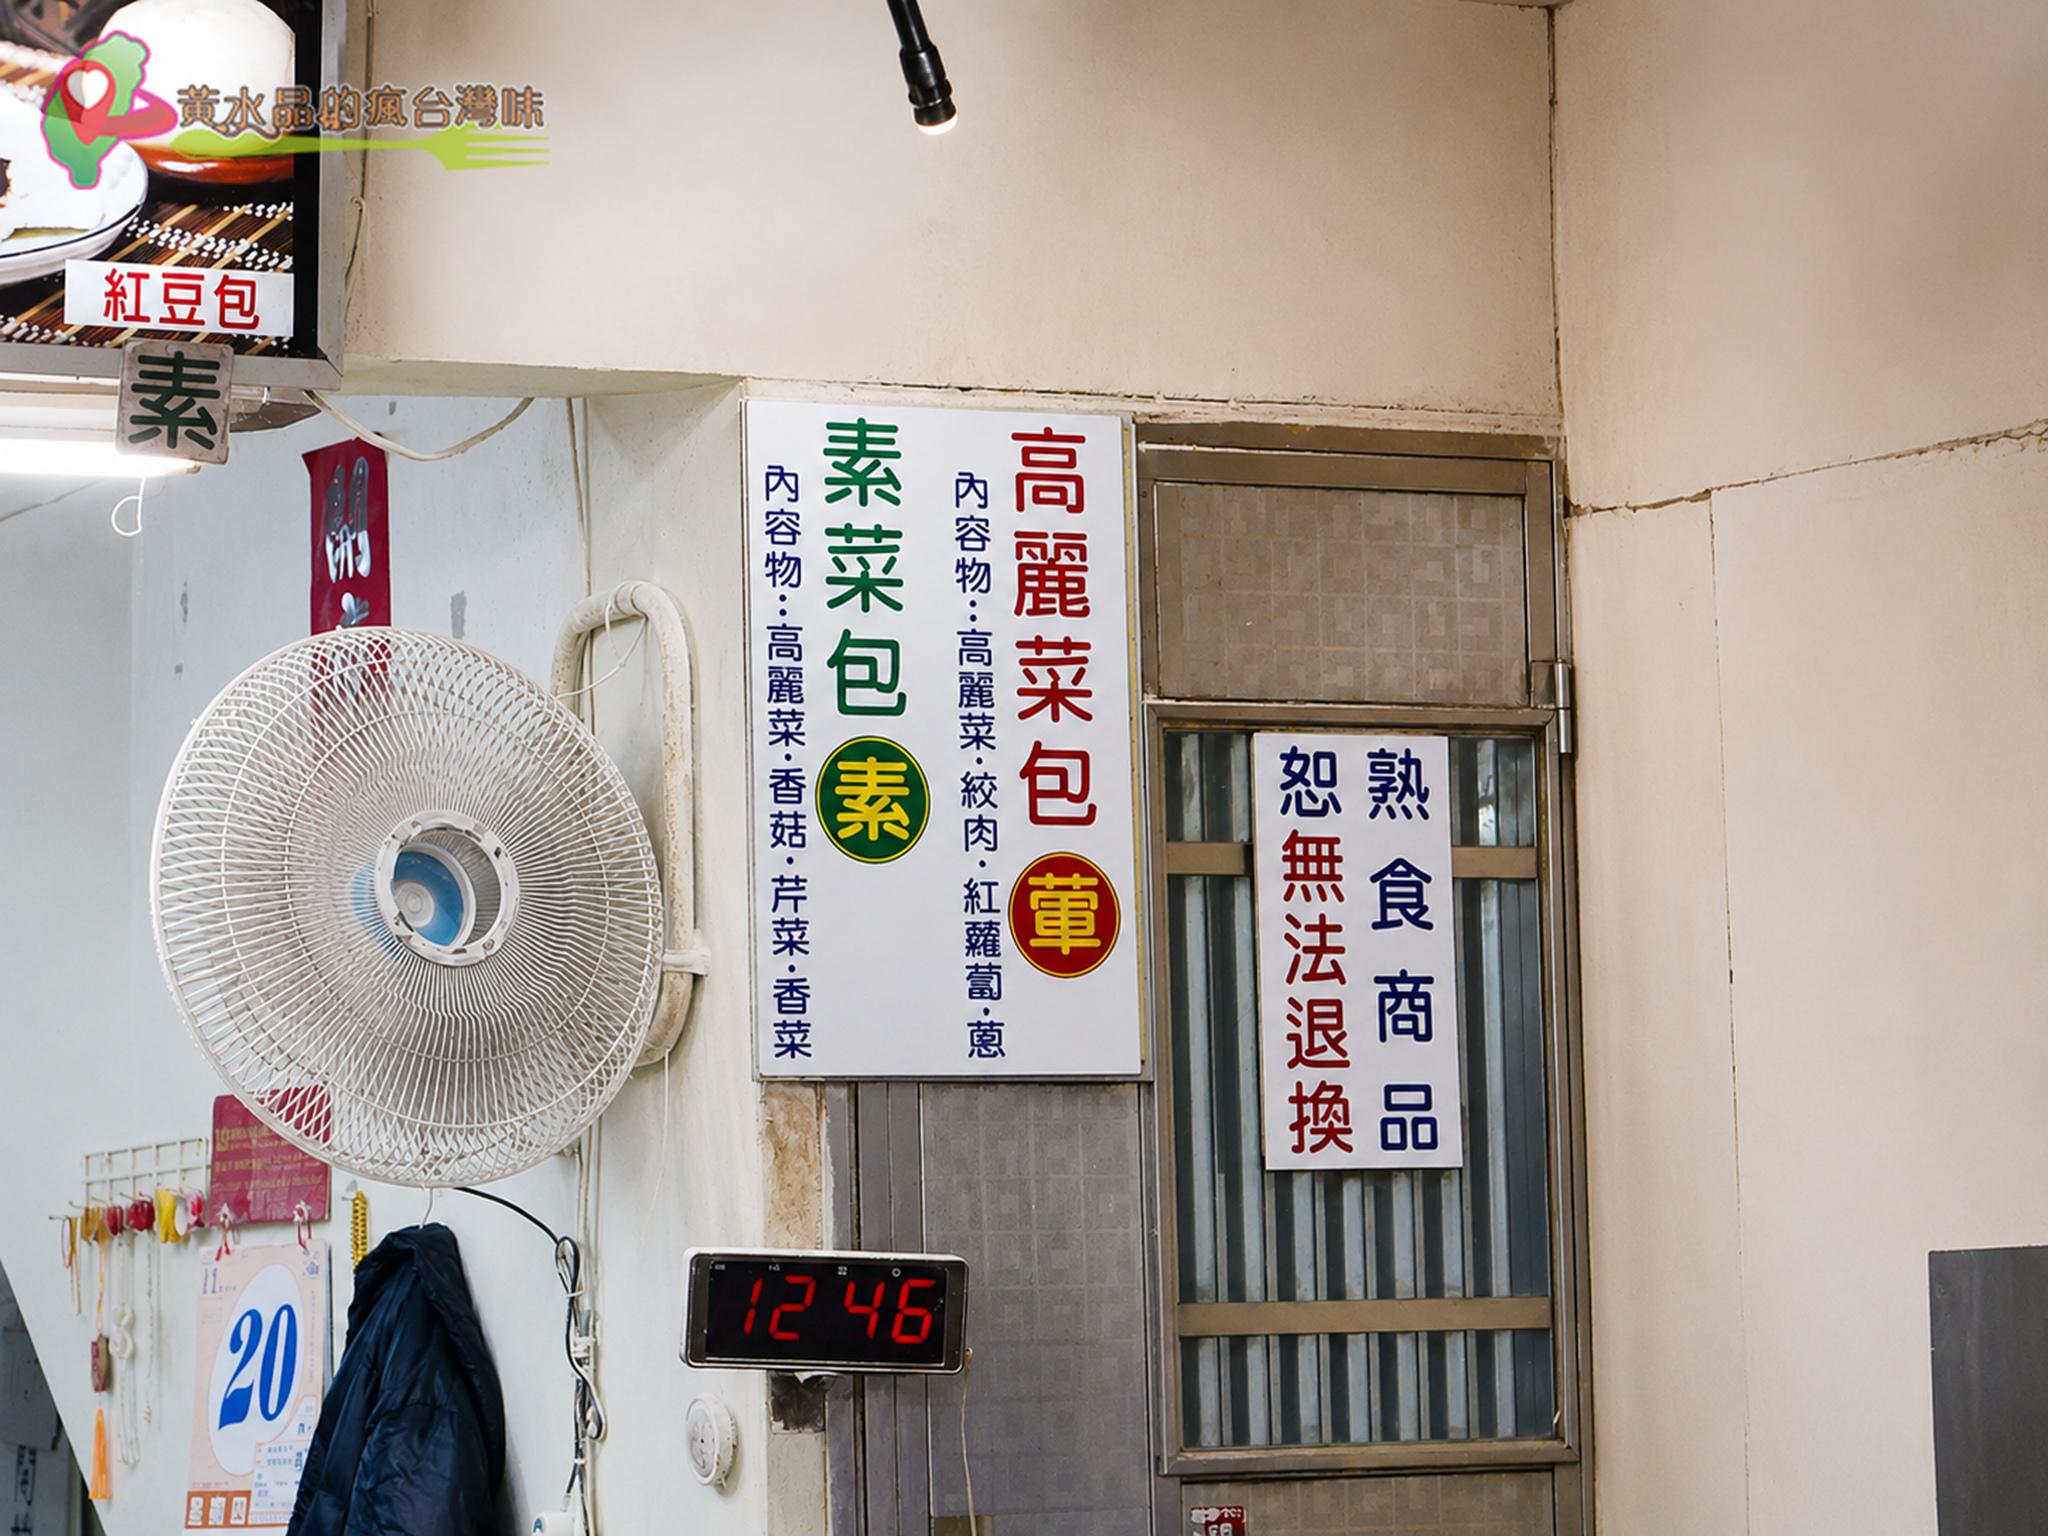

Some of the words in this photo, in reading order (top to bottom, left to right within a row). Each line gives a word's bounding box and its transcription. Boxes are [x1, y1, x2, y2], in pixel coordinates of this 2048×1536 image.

[103, 268, 261, 331] 紅豆包
[130, 350, 221, 451] 素
[823, 417, 907, 716] 素菜包
[1011, 426, 1097, 826] 高麗菜包
[835, 756, 911, 841] 素
[1028, 873, 1101, 955] 葷
[1279, 745, 1353, 1154] 恕無法退換
[1367, 748, 1439, 1151] 熟食商品
[218, 1303, 299, 1430] 20
